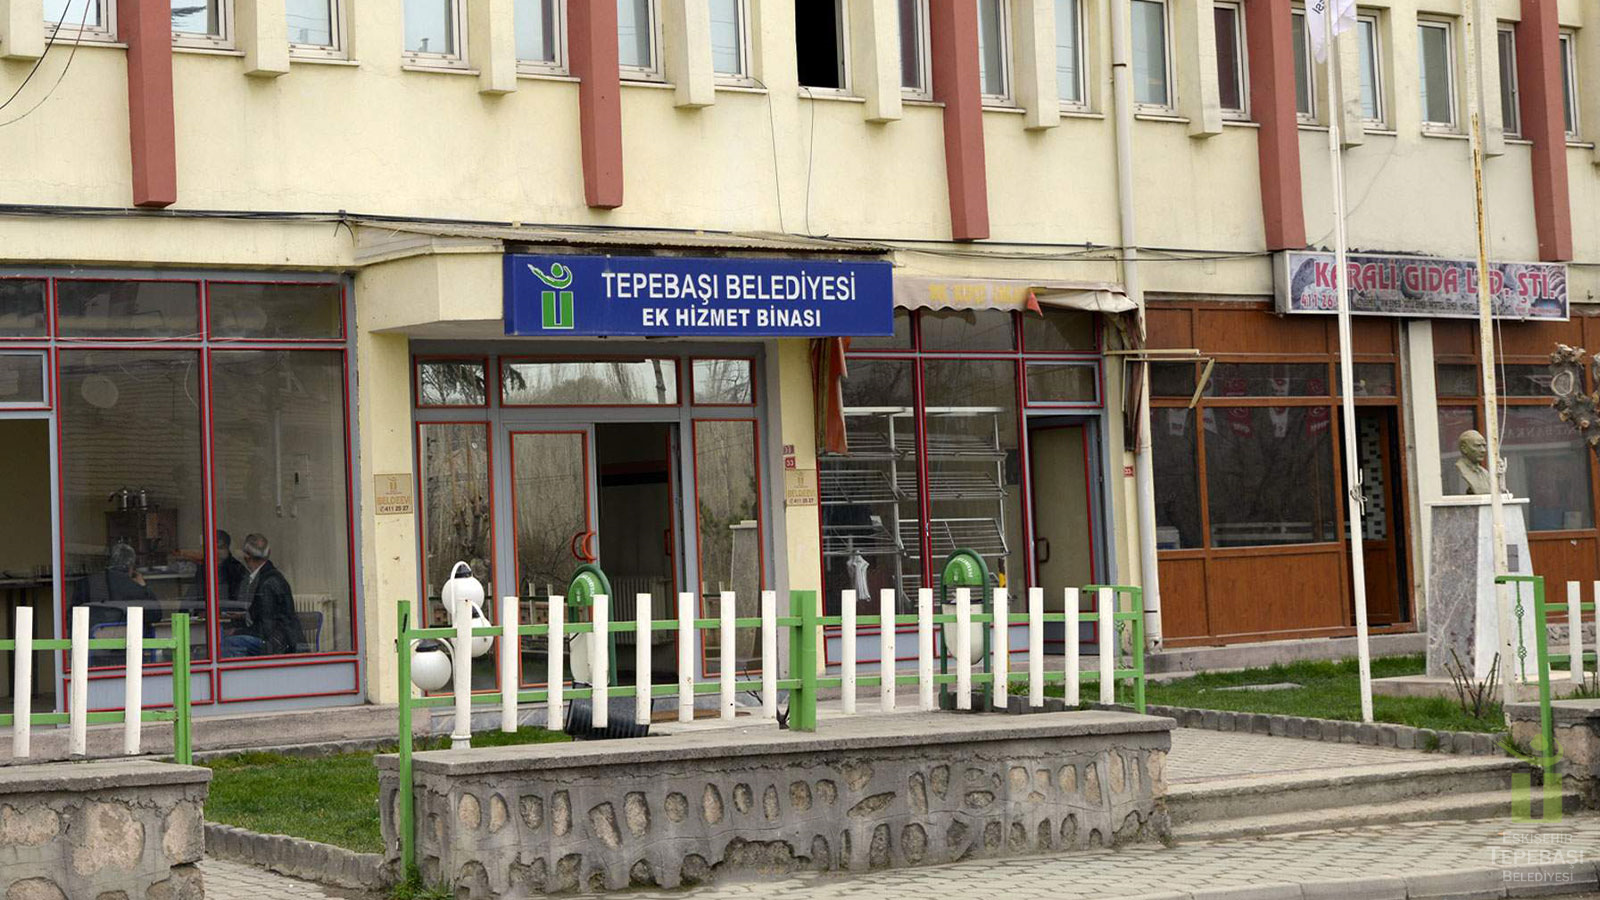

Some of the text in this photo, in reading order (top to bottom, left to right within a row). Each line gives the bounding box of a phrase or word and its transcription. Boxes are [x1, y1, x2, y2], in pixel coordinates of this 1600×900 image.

[601, 270, 856, 306] TEPEBAŞI BELEDİYESİ
[1403, 264, 1458, 294] GIDA
[1465, 268, 1510, 296] LD.
[642, 304, 821, 327] EK HİZMET BİNASI
